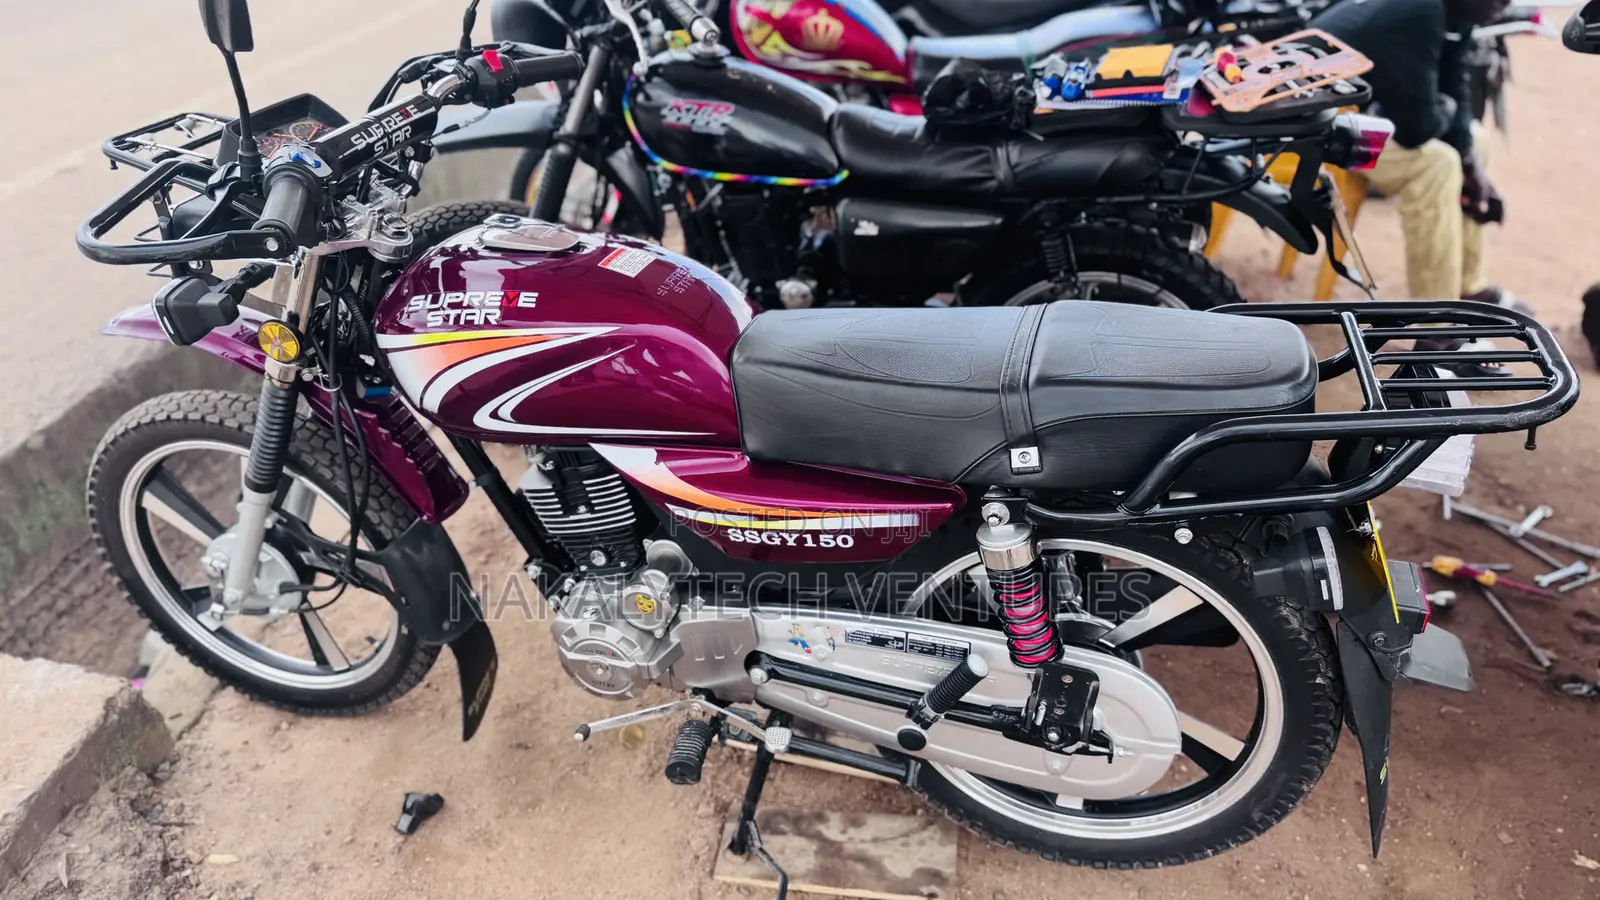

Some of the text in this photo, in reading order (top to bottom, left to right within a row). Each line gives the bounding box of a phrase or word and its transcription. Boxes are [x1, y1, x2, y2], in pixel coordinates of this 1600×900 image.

[408, 291, 539, 311] SUPREME
[427, 308, 501, 327] STAR
[727, 528, 855, 549] SSGY150
